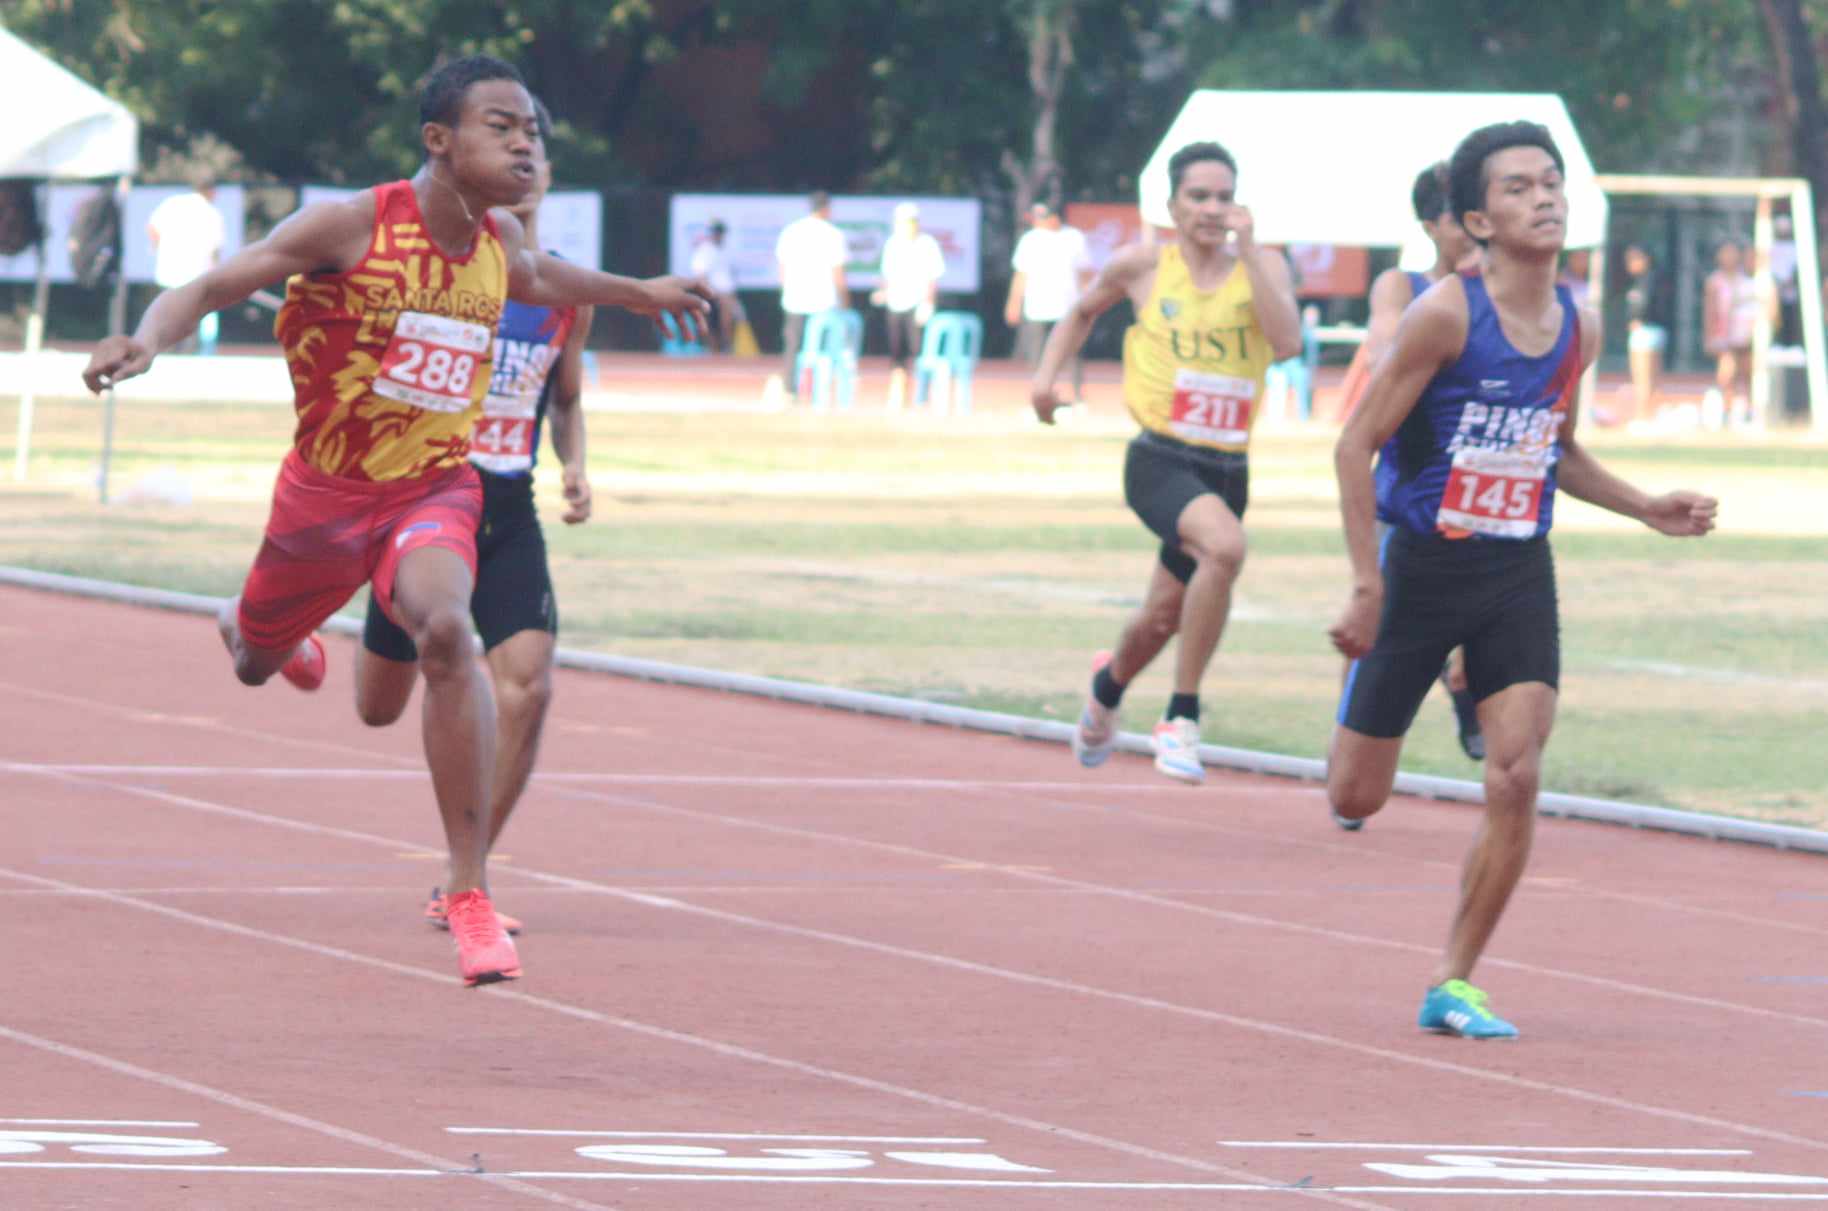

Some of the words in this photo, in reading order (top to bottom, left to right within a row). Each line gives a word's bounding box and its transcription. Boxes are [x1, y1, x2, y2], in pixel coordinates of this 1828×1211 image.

[365, 284, 450, 314] SANTA
[1170, 326, 1254, 362] UST
[388, 341, 474, 393] 288
[1183, 393, 1238, 427] 211
[1459, 474, 1535, 517] 145
